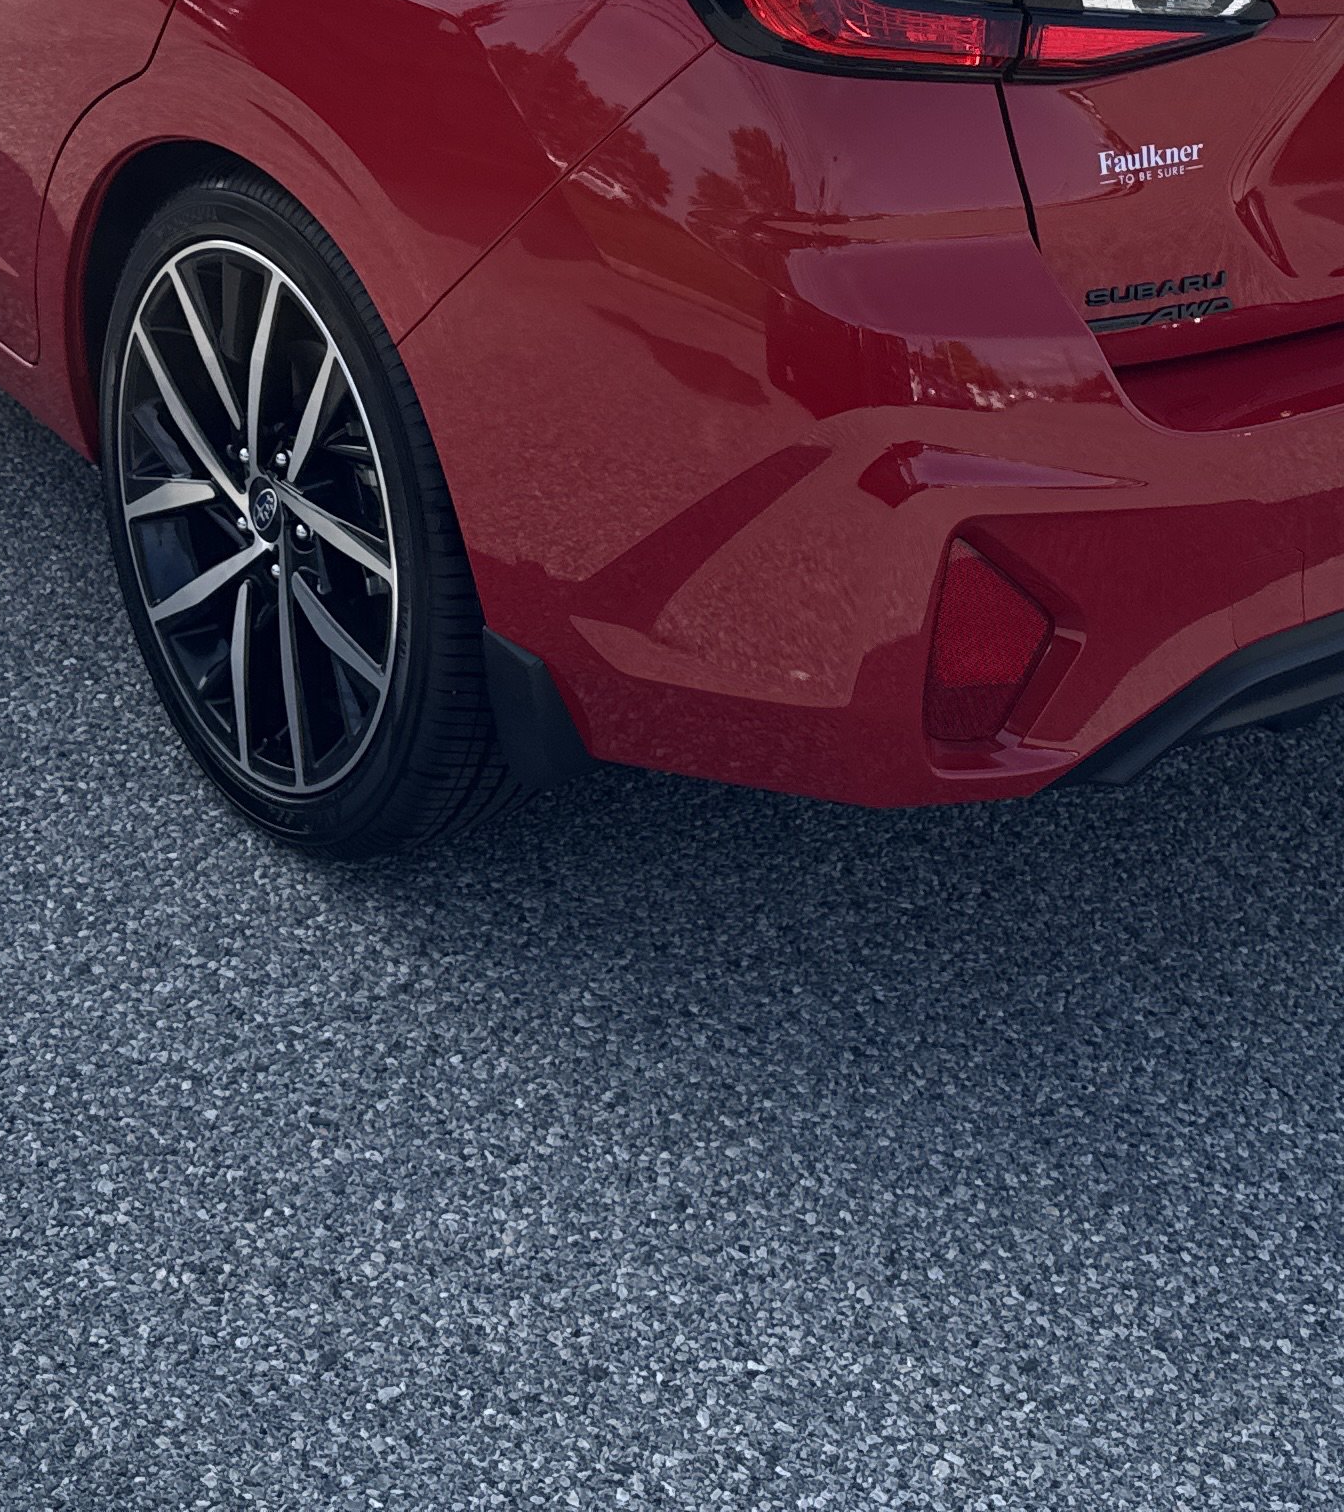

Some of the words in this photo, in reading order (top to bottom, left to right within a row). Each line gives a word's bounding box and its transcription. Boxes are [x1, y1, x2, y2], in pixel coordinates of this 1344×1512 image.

[1098, 143, 1204, 176] Faulkner
[1119, 173, 1135, 185] TO
[1139, 170, 1153, 182] BE
[1157, 165, 1185, 179] SURE
[1085, 270, 1227, 307] SUBARU
[1144, 296, 1233, 324] AWD
